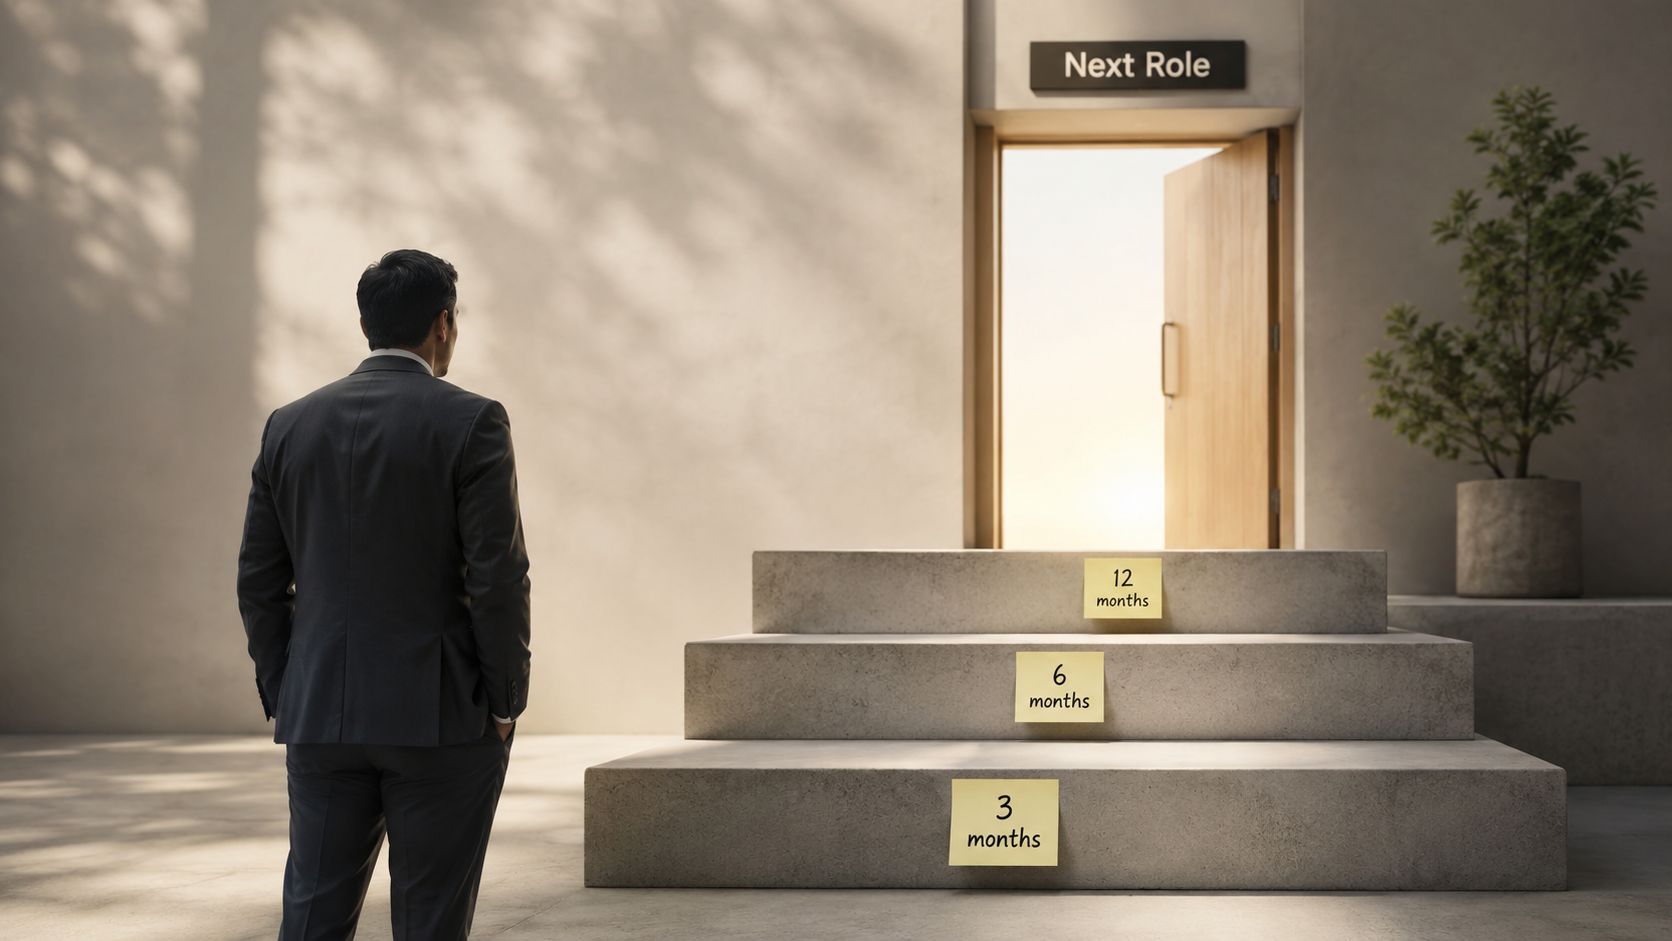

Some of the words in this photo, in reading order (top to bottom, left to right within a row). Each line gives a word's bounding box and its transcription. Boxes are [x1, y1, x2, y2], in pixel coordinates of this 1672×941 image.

[1064, 51, 1135, 78] Next
[1146, 51, 1211, 78] Role
[1113, 568, 1134, 587] 12
[1096, 592, 1149, 608] months
[1053, 663, 1067, 686] 6
[1029, 691, 1091, 709] months
[995, 794, 1013, 821] 3
[967, 826, 1041, 849] months
